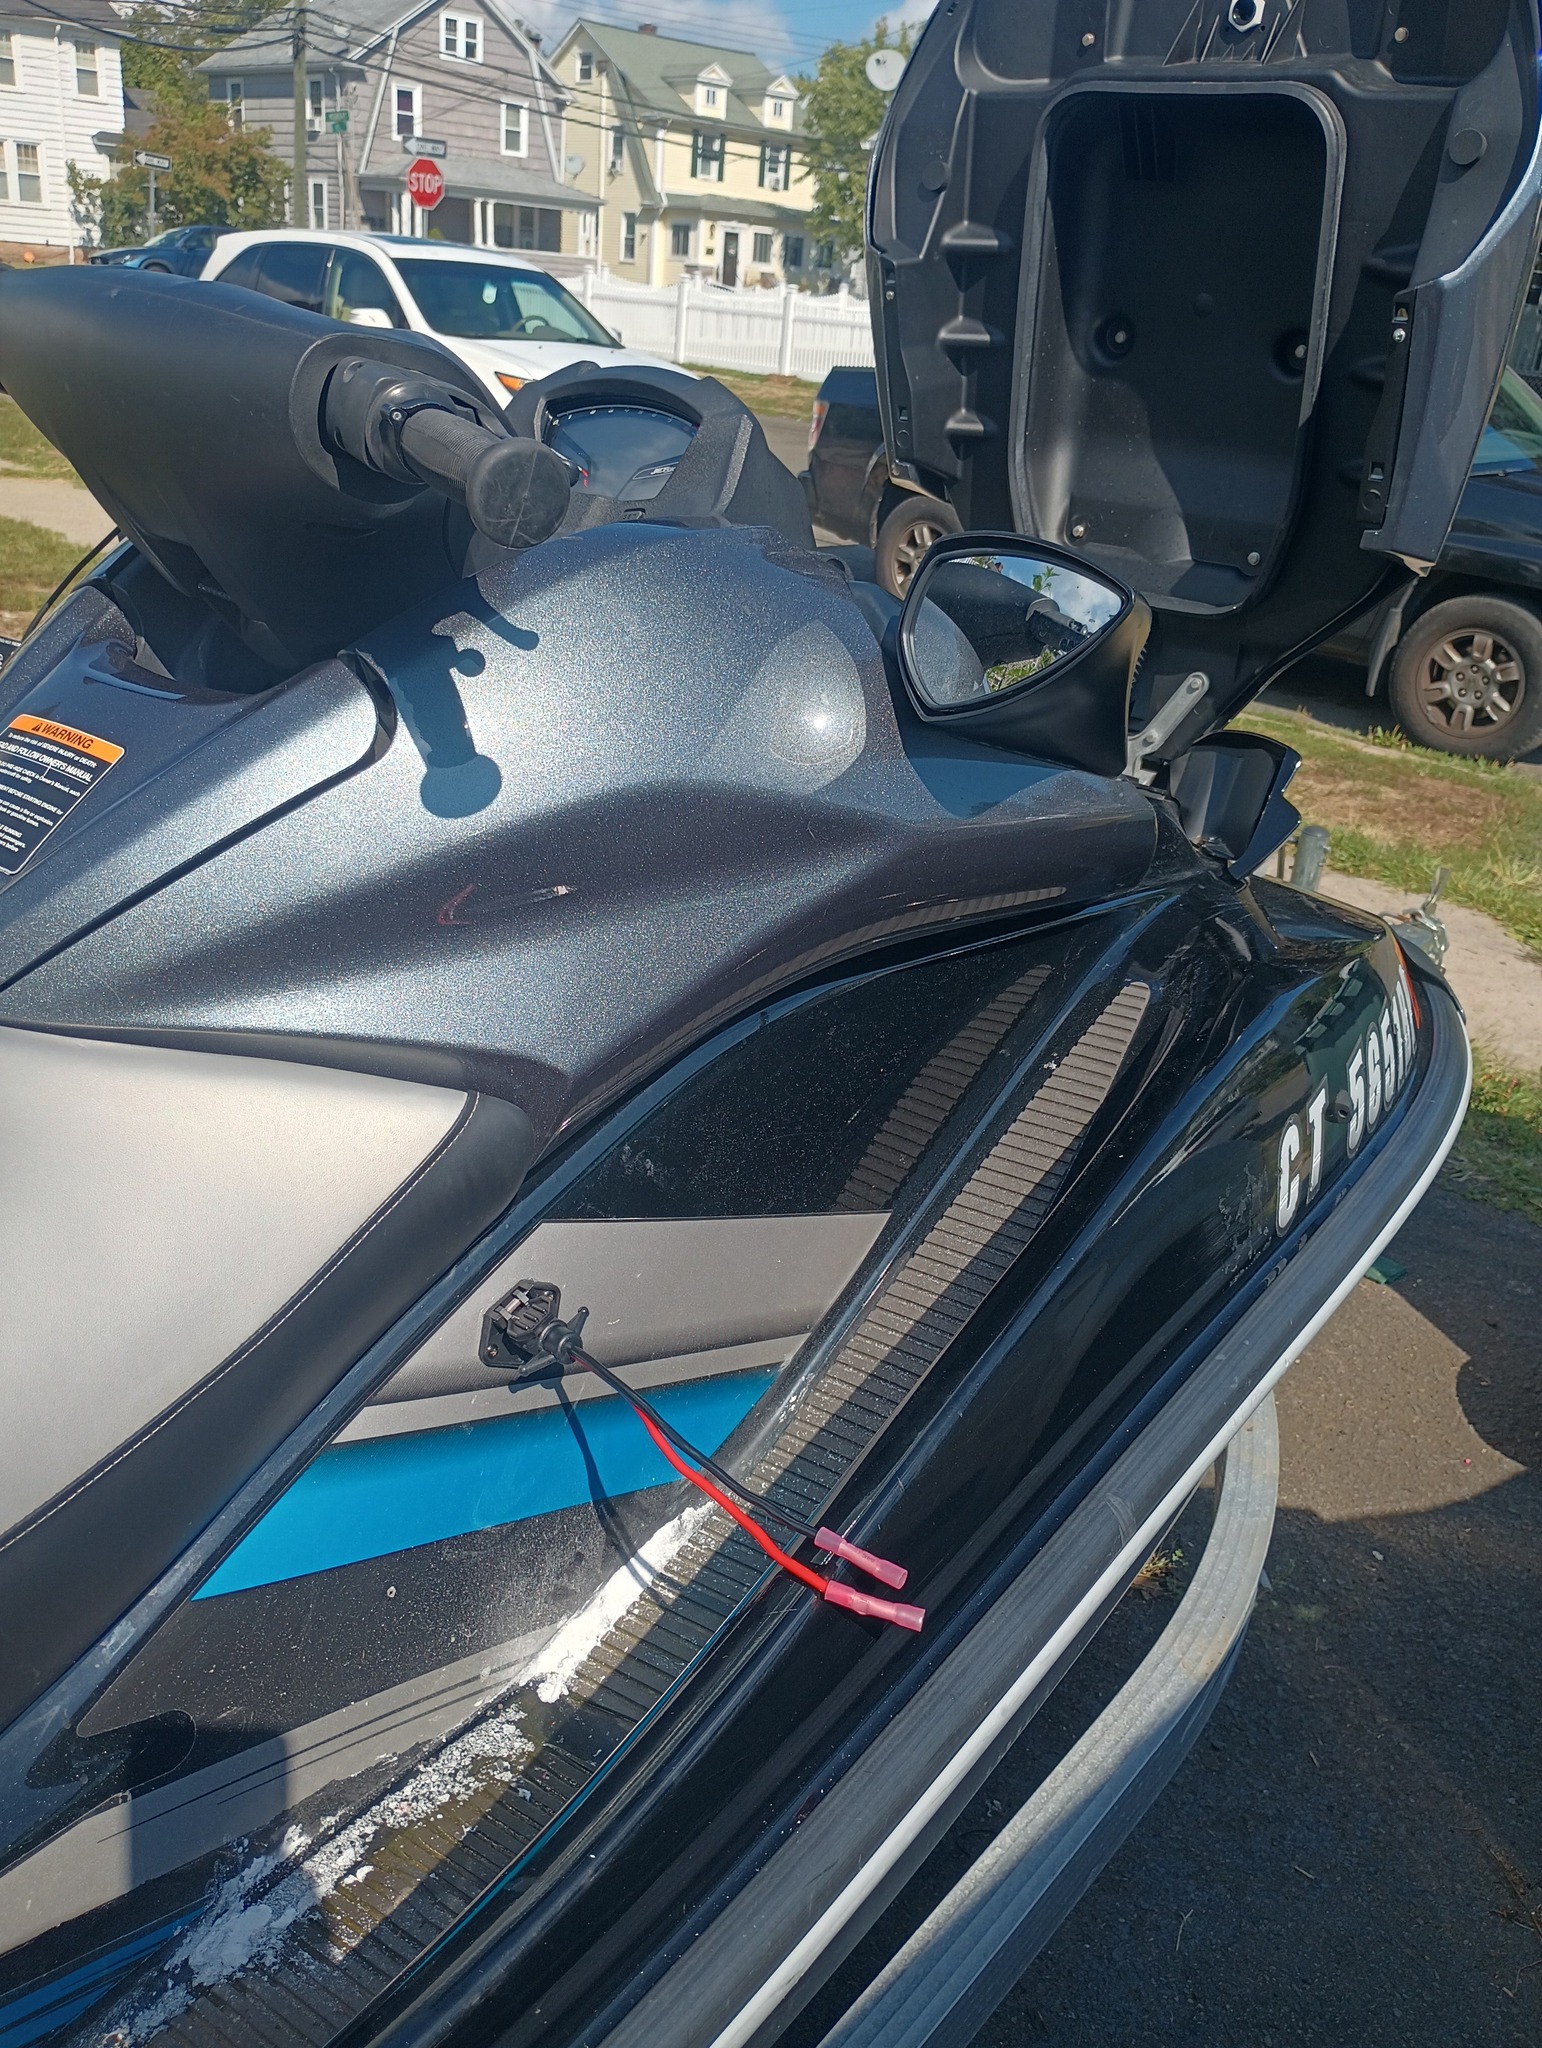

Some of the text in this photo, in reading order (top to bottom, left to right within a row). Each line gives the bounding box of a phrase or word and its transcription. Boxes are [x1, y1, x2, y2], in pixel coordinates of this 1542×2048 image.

[409, 172, 442, 194] STOP
[41, 722, 94, 750] WARNING
[7, 744, 20, 753] AND
[17, 747, 42, 759] FOLLOW
[38, 754, 68, 770] OWNER'S
[65, 764, 93, 782] MANUAL
[1277, 1080, 1328, 1232] CT
